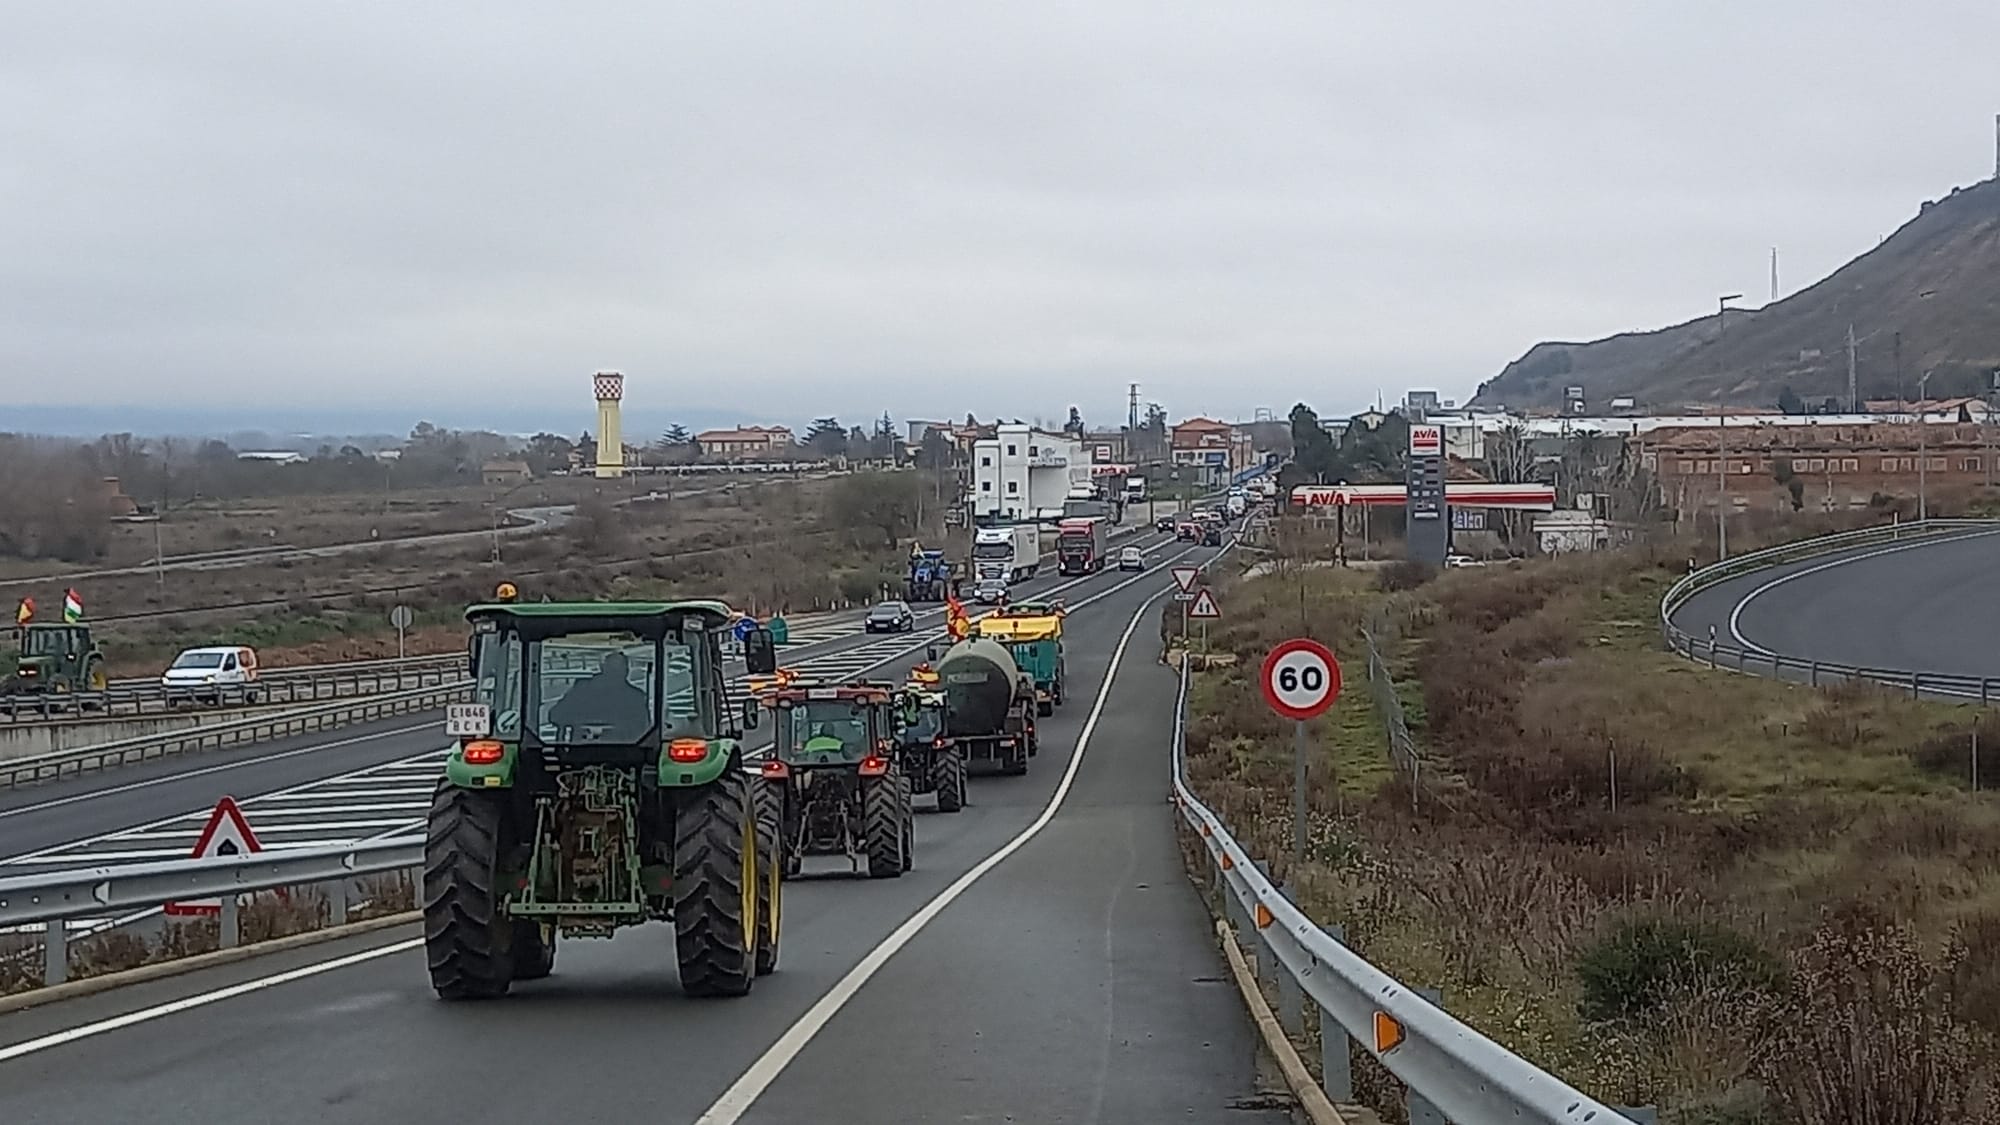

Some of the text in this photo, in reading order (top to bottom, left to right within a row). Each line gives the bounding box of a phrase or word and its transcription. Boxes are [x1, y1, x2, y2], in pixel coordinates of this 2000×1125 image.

[1413, 429, 1438, 438] AVIA
[1310, 491, 1345, 504] AVIA
[1279, 666, 1322, 692] 60
